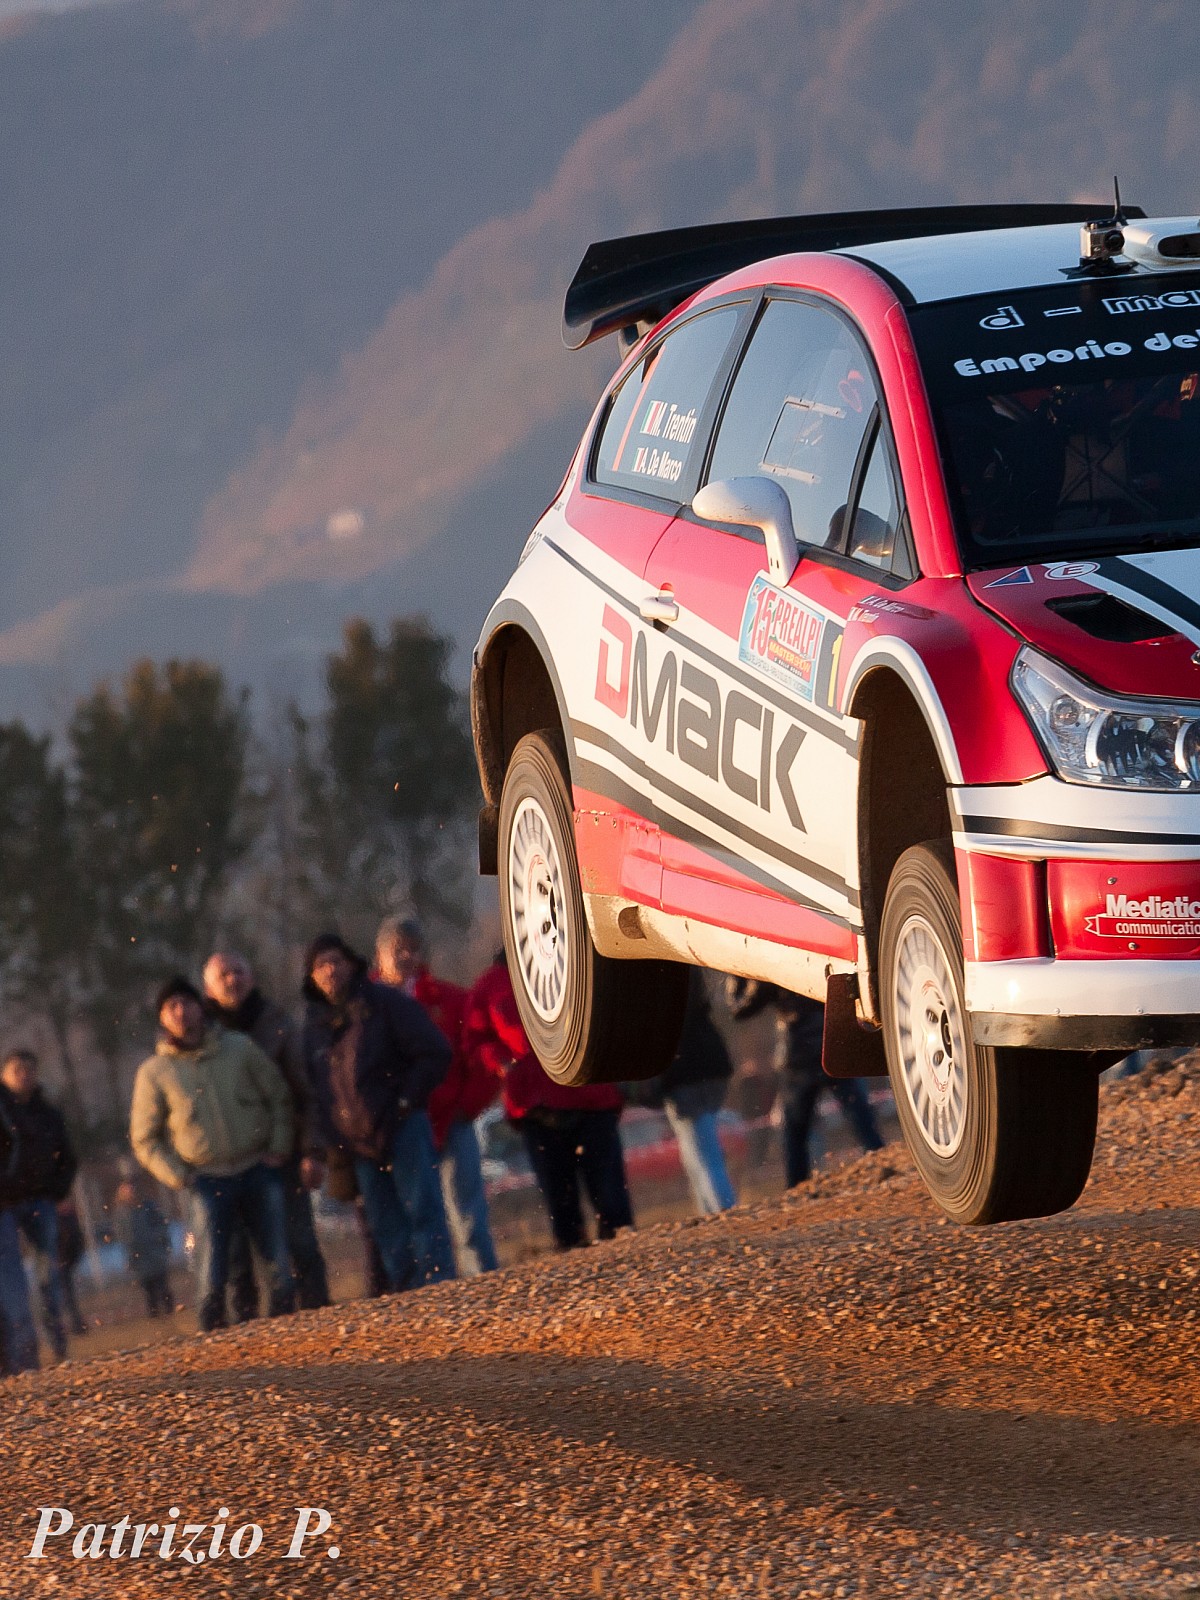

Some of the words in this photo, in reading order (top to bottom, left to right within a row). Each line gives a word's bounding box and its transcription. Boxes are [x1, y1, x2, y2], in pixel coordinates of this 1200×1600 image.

[978, 305, 1022, 331] d
[953, 339, 1133, 379] Emporio
[661, 404, 697, 444] Trentin
[656, 451, 683, 482] Marco
[750, 586, 778, 657] 15
[771, 597, 823, 660] PREALPI
